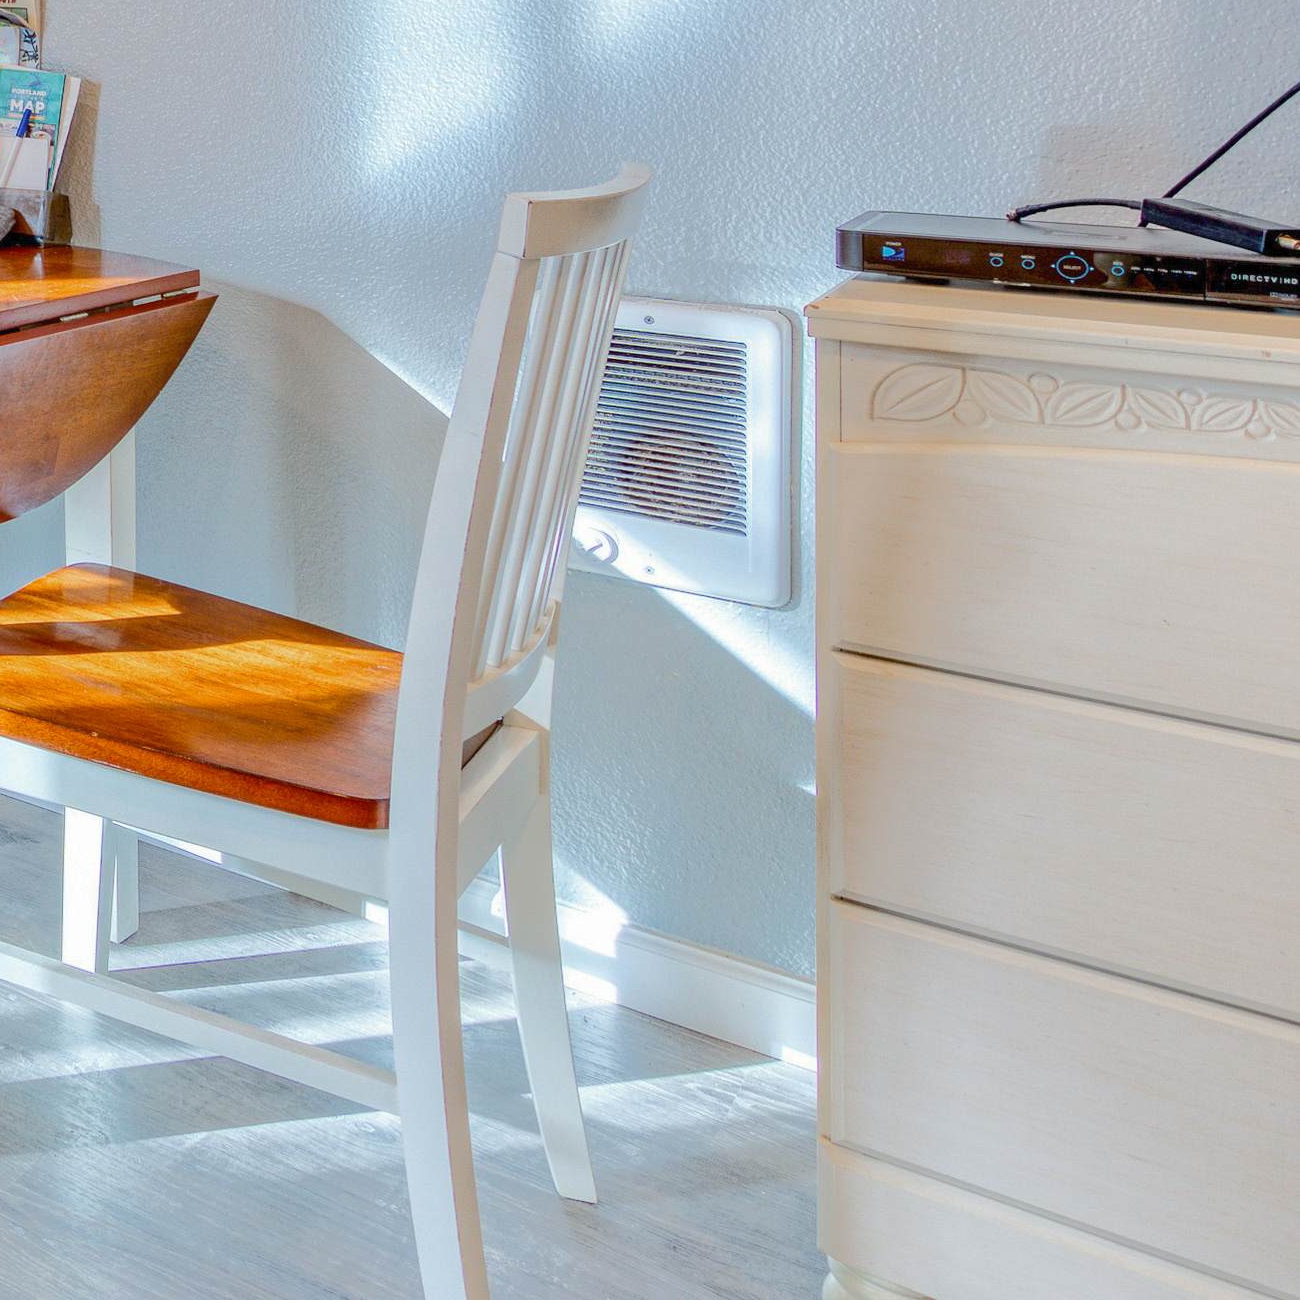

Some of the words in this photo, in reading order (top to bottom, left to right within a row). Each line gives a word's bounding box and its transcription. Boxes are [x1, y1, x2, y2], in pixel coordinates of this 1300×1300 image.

[11, 87, 47, 97] PORTLAND
[10, 98, 46, 113] MAP
[1230, 273, 1278, 284] DIRECTV
[1283, 277, 1299, 285] HD
